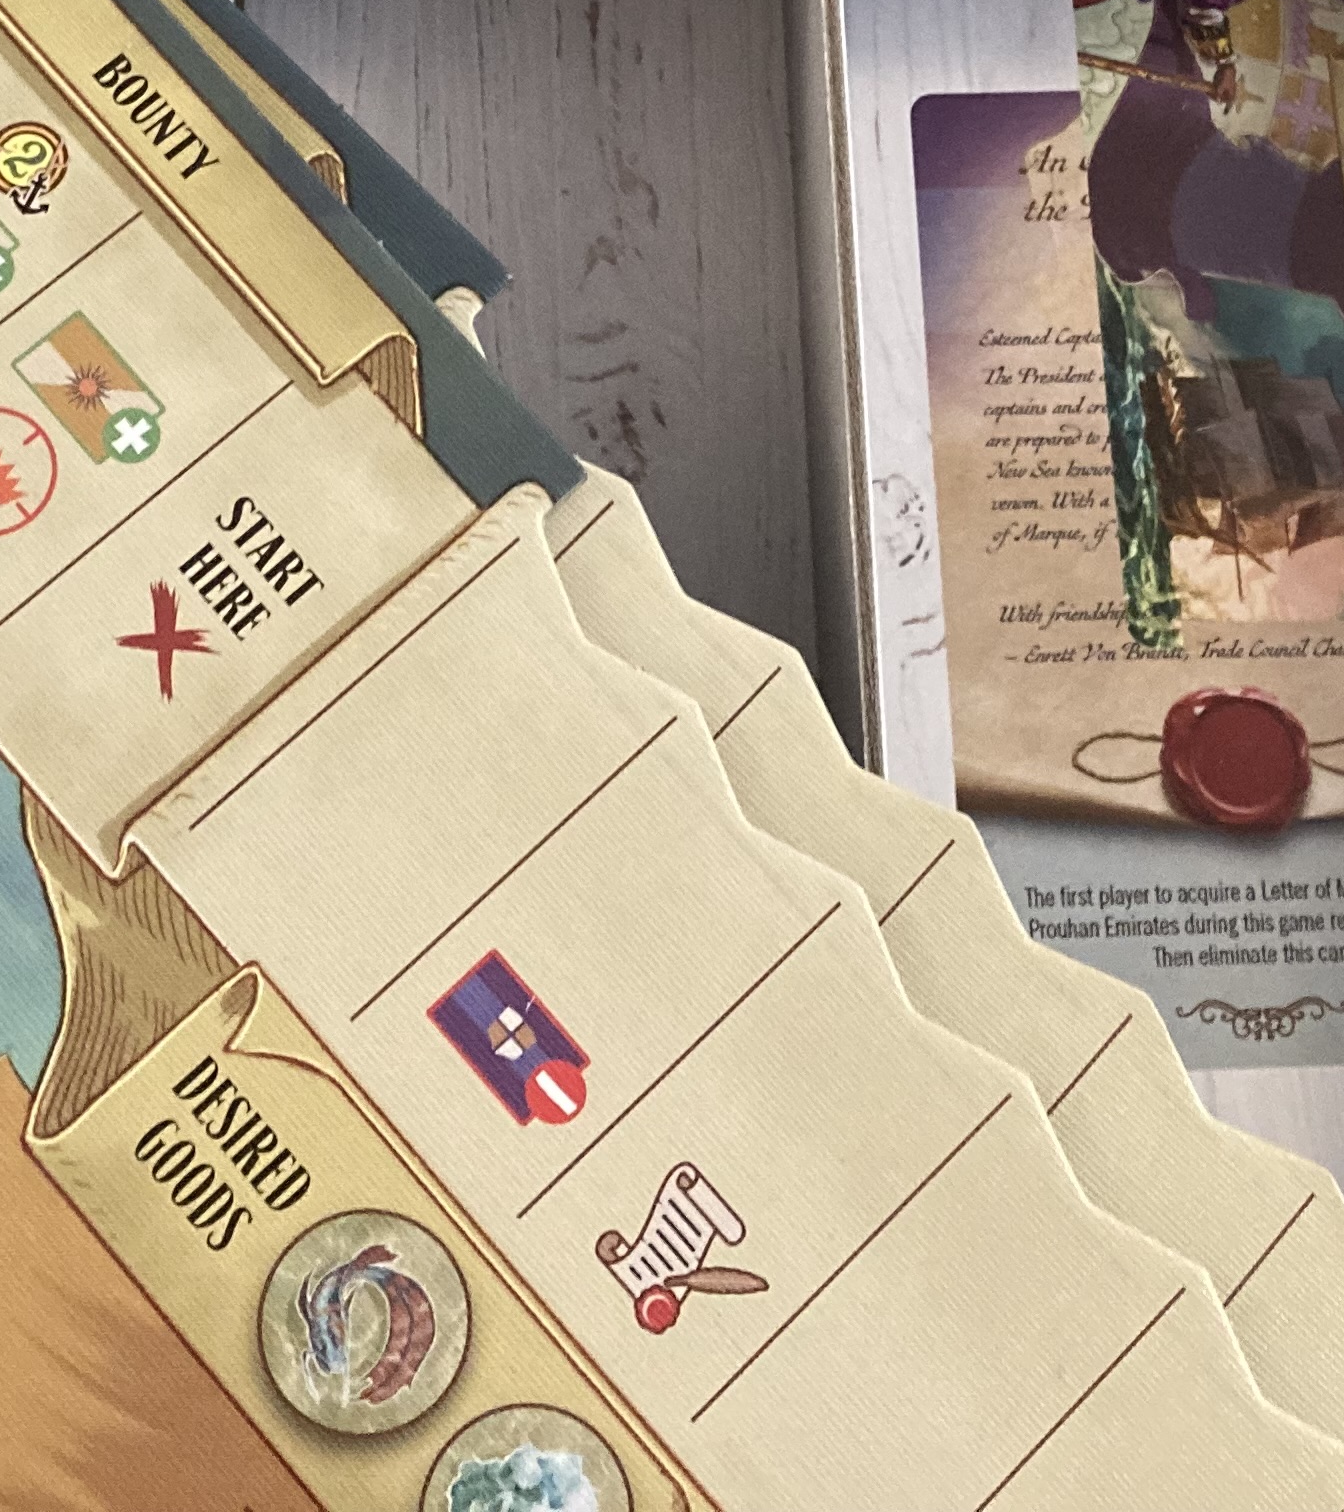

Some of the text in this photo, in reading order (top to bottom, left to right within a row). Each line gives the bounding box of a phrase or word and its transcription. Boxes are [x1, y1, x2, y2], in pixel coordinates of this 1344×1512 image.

[92, 52, 220, 179] BOUNTY
[3, 141, 47, 178] 2
[1024, 191, 1067, 221] the
[979, 327, 1053, 347] Esteemed
[985, 365, 1096, 385] The President
[983, 397, 1047, 422] captains
[1052, 396, 1086, 415] and
[985, 436, 1010, 448] are
[1010, 424, 1082, 455] prepared
[1086, 432, 1101, 445] to
[987, 458, 1026, 479] New
[1029, 459, 1061, 478] Sea
[1052, 489, 1094, 509] With
[1100, 497, 1110, 507] a
[215, 496, 325, 607] START
[178, 542, 271, 642] HERE
[999, 602, 1043, 623] With
[1200, 637, 1244, 659] Trade
[1248, 637, 1311, 658] Council
[1024, 886, 1055, 908] The
[1060, 884, 1094, 907] first
[1099, 884, 1150, 909] player
[1155, 884, 1172, 904] to
[1177, 880, 1241, 906] acquire
[1246, 886, 1256, 903] a
[1261, 878, 1309, 901] Letter
[1315, 877, 1332, 900] of
[1029, 918, 1100, 939] Prouhan
[1105, 915, 1180, 938] Emirates
[1184, 913, 1239, 938] during
[1243, 912, 1275, 933] this
[1278, 915, 1325, 938] game
[1153, 945, 1193, 967] Then
[1198, 942, 1278, 966] eliminate
[1283, 940, 1314, 964] this
[171, 1055, 311, 1211] DESIRED
[134, 1119, 253, 1251] GOODS
